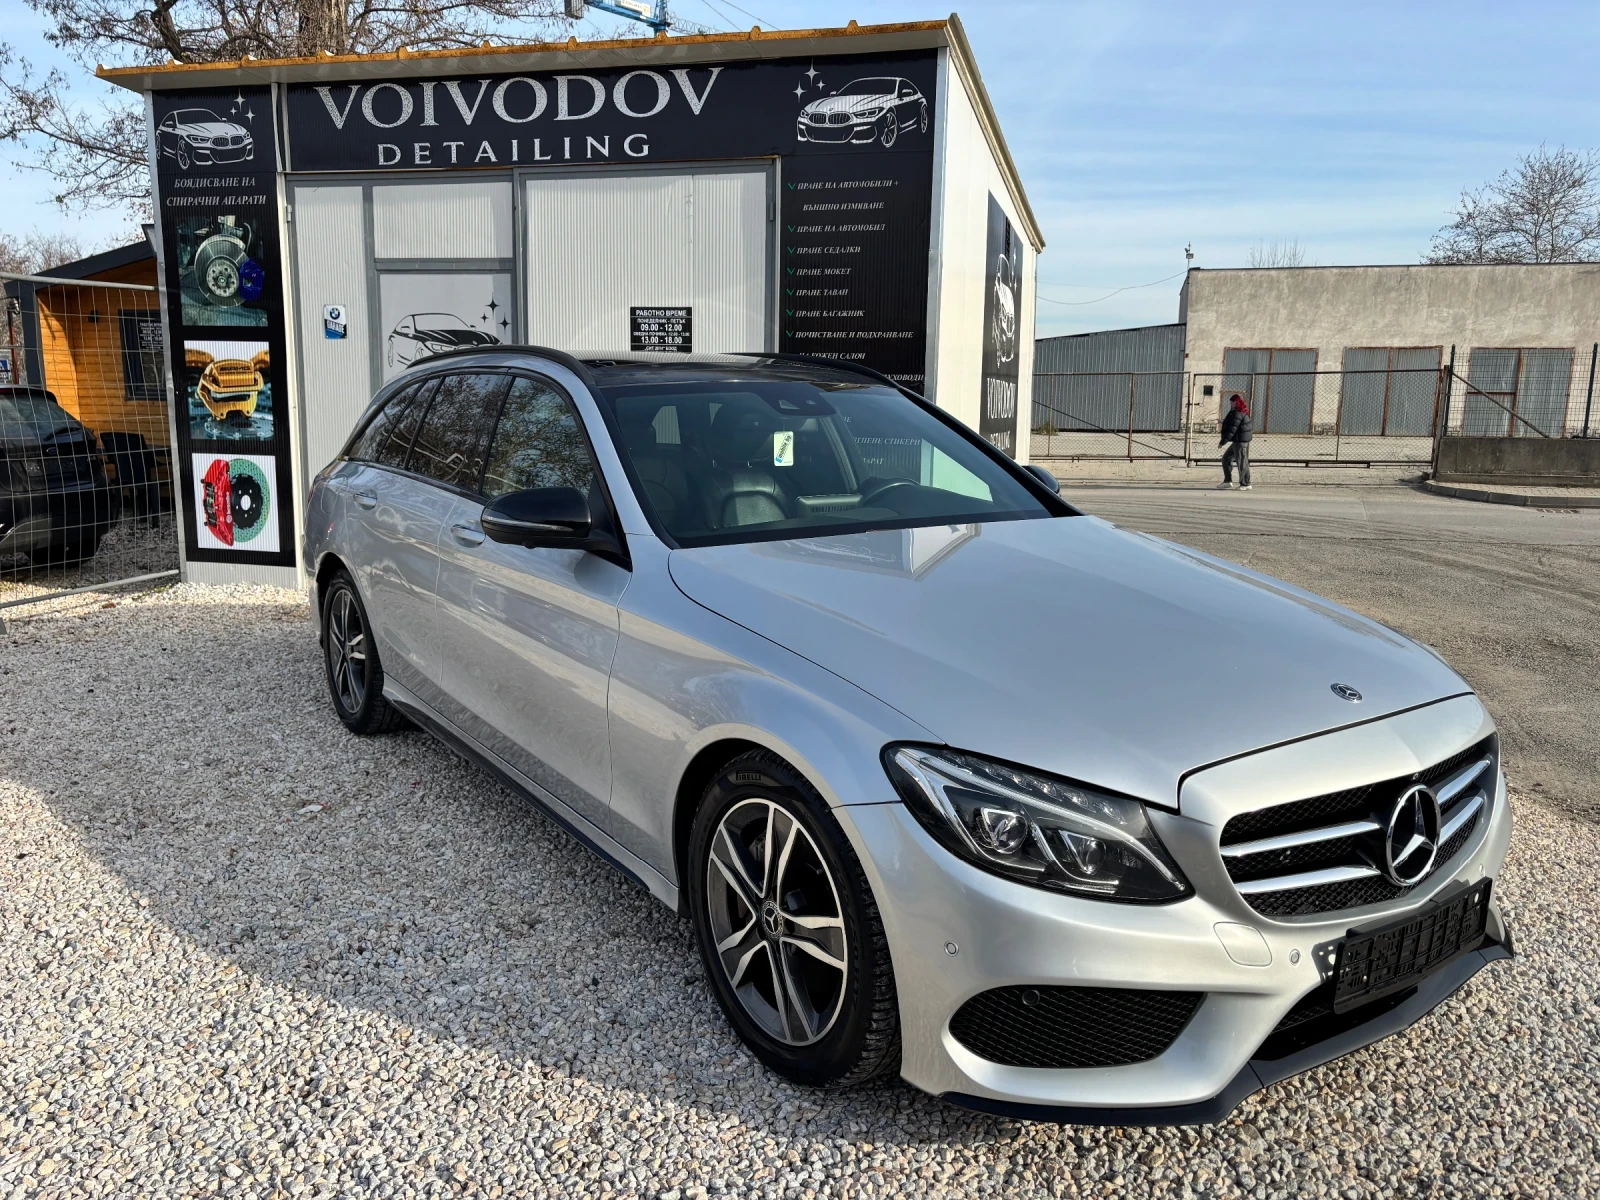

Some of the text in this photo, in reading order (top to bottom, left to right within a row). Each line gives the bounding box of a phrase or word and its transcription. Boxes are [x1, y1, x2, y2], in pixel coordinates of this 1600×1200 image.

[313, 66, 725, 130] VOIVODOV
[377, 133, 651, 166] DETAILING
[174, 176, 256, 189] БОЯДИСВАНЕ НА
[797, 182, 824, 190] ПРАНЕ
[825, 181, 836, 189] НА
[837, 179, 893, 189] АВТОМОБИЛИ
[166, 194, 267, 207] СПИРАЧНИ АПАРАТИ
[803, 202, 885, 211] ВЪНШНО ИЗМИВАНЕ
[796, 225, 823, 233] ПРАНЕ
[837, 224, 886, 232] АВТОМОБИЛ
[824, 246, 861, 254] СЕДАЛКИ
[796, 268, 822, 276] ПРАНЕ
[795, 310, 822, 318] ПРАНЕ
[795, 331, 848, 339] ПОЧИСТВАНЕ
[856, 331, 914, 339] ПОДХРАНВАНЕ
[839, 352, 866, 360] САЛОН
[884, 373, 924, 382] УХОВОДИ
[735, 770, 762, 781] PIRELLI
